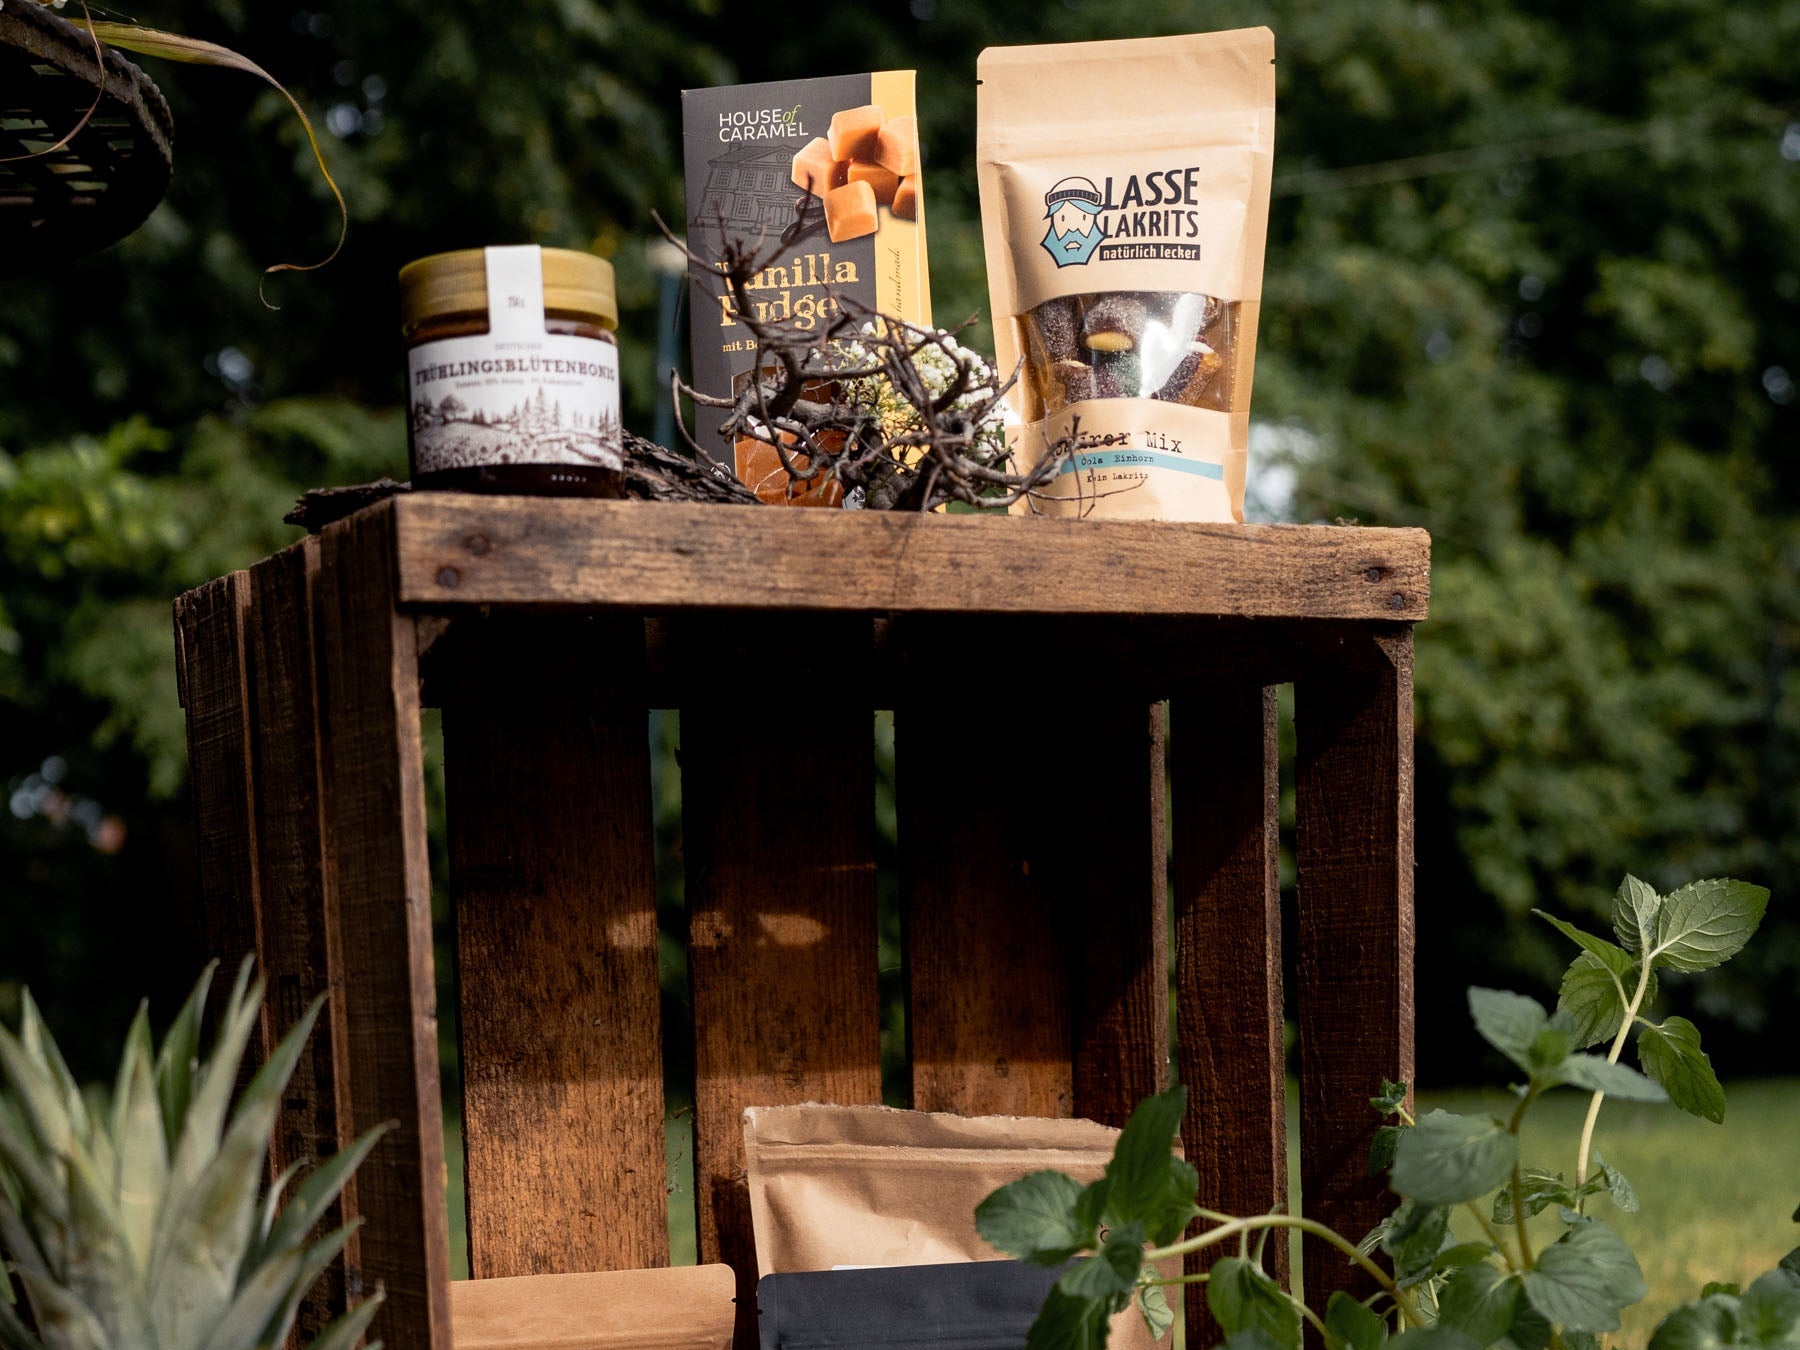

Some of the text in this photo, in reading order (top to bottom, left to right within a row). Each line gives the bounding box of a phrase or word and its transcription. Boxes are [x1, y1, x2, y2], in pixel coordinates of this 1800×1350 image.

[719, 105, 801, 127] HOUSE of
[719, 122, 808, 142] CARAMEL
[1102, 167, 1200, 211] LASSE
[1102, 210, 1199, 238] LAKRITS
[1102, 245, 1197, 260] natürlich lecker
[722, 340, 743, 352] mit
[415, 355, 616, 386] FRÜHLINGSBLÜTENHONIG
[1145, 430, 1182, 453] Mix
